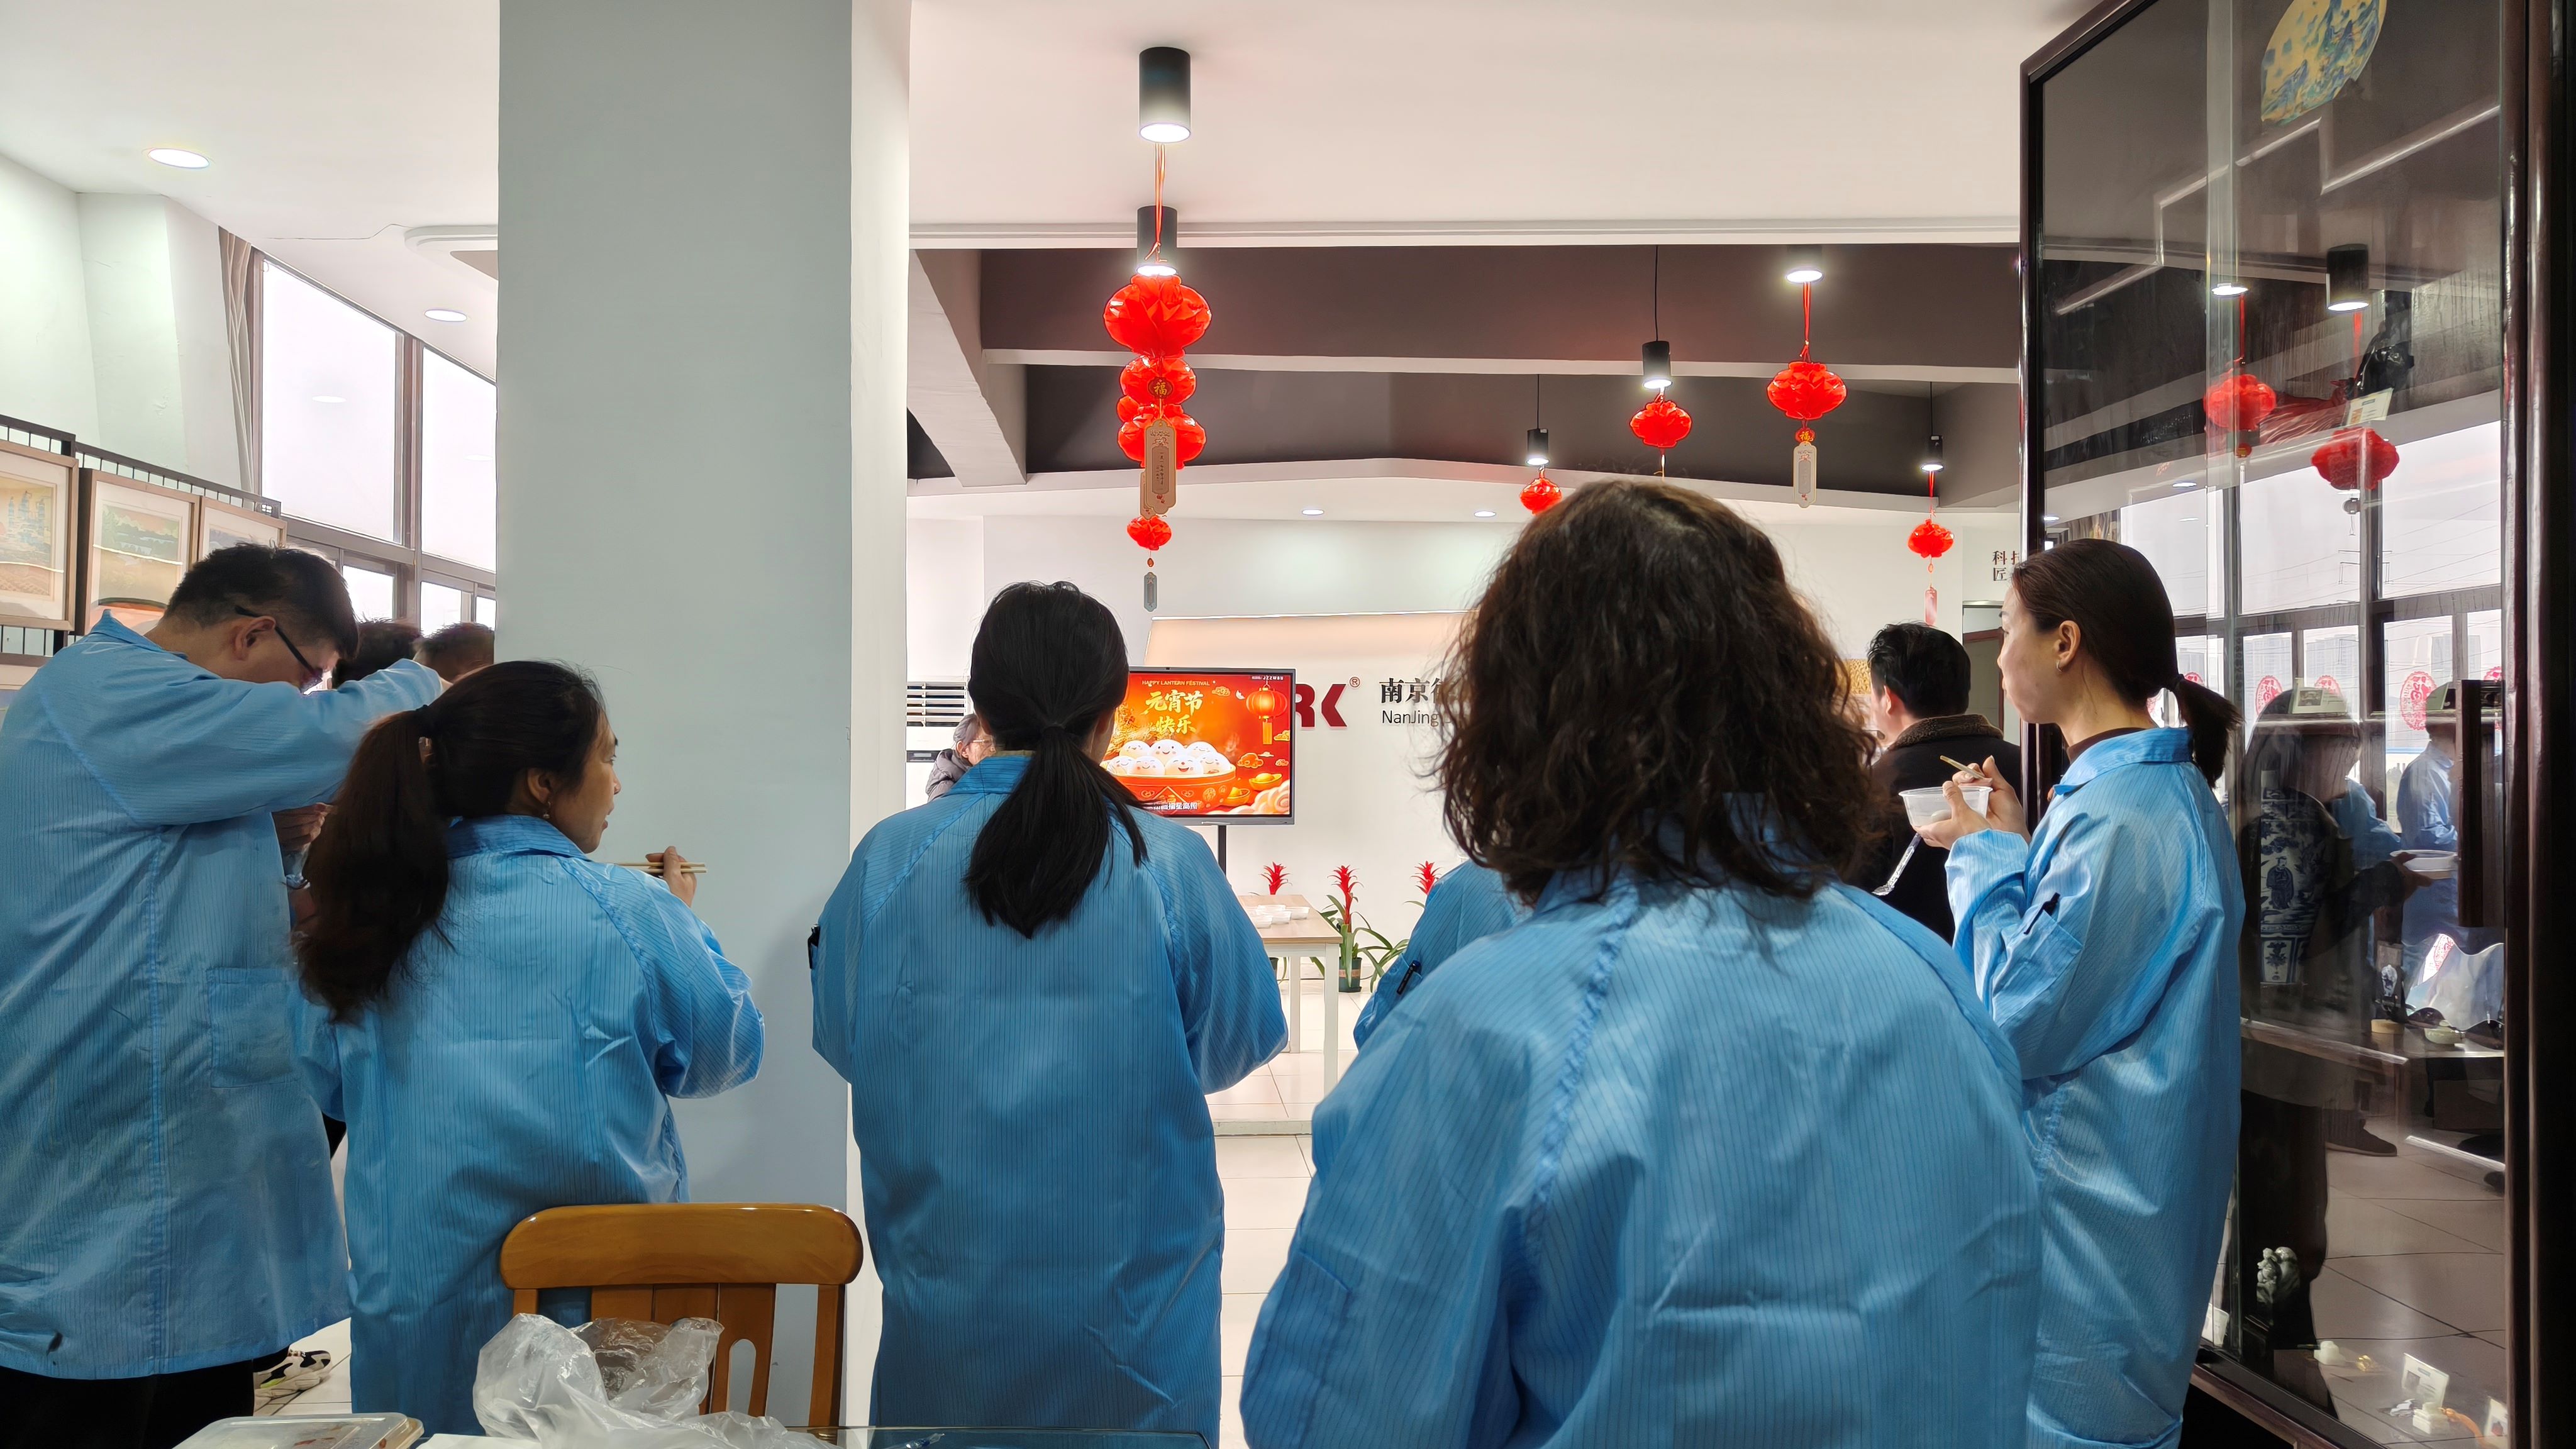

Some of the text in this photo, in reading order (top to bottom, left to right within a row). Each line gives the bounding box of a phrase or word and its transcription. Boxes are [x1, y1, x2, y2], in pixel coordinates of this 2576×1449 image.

[1153, 381, 1168, 396] 福
[1140, 689, 1204, 716] 元宵节
[1155, 714, 1196, 735] 快乐
[1382, 710, 1439, 727] NanJing
